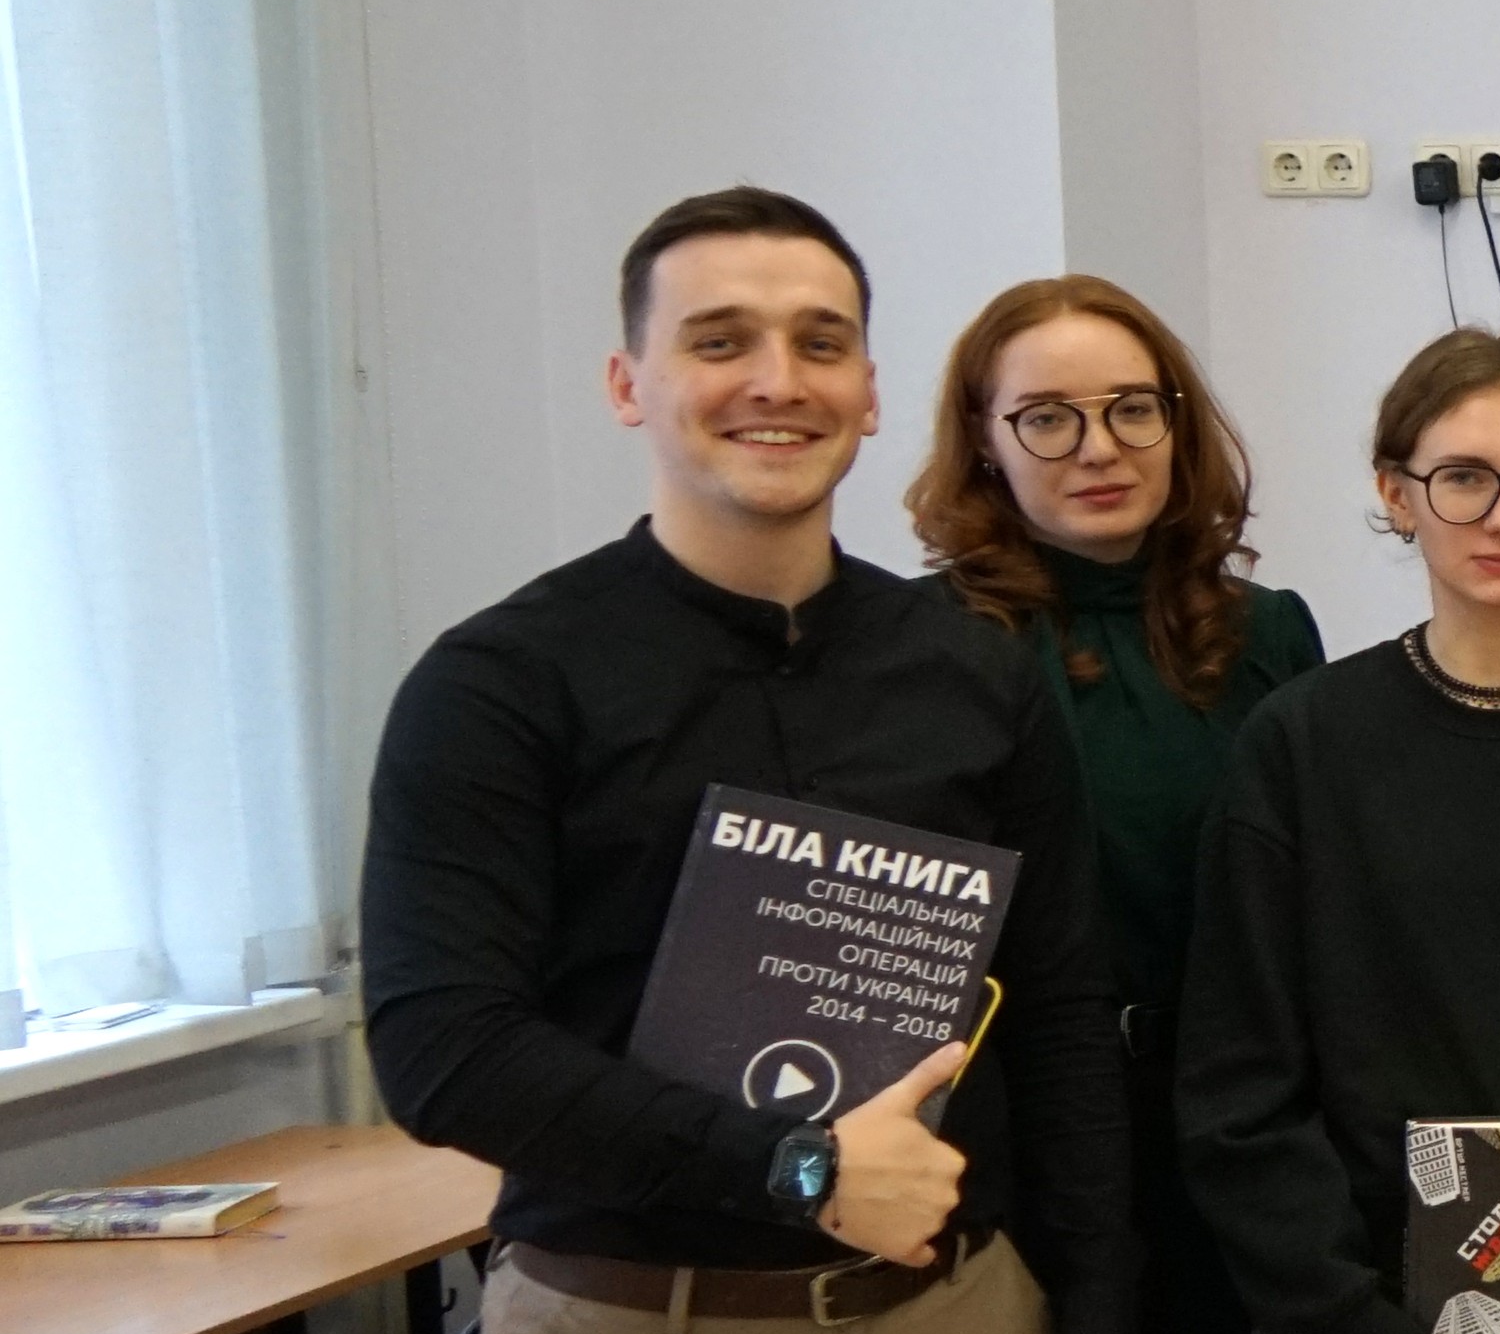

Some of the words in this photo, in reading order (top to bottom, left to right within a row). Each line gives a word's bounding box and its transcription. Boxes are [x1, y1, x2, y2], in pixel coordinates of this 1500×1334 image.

[712, 811, 824, 868] БІЛА
[835, 839, 992, 905] КНИГА
[757, 897, 976, 960] ІНФОРМАЦІЙНИХ
[806, 878, 985, 934] СПЕЦІАЛЬНИХ
[758, 956, 849, 992] ПРОТИ
[854, 975, 960, 1015] УКРАЇНИ
[839, 944, 968, 988] ОПЕРАЦІЙ
[807, 996, 865, 1024] 2014
[893, 1013, 952, 1042] 2018
